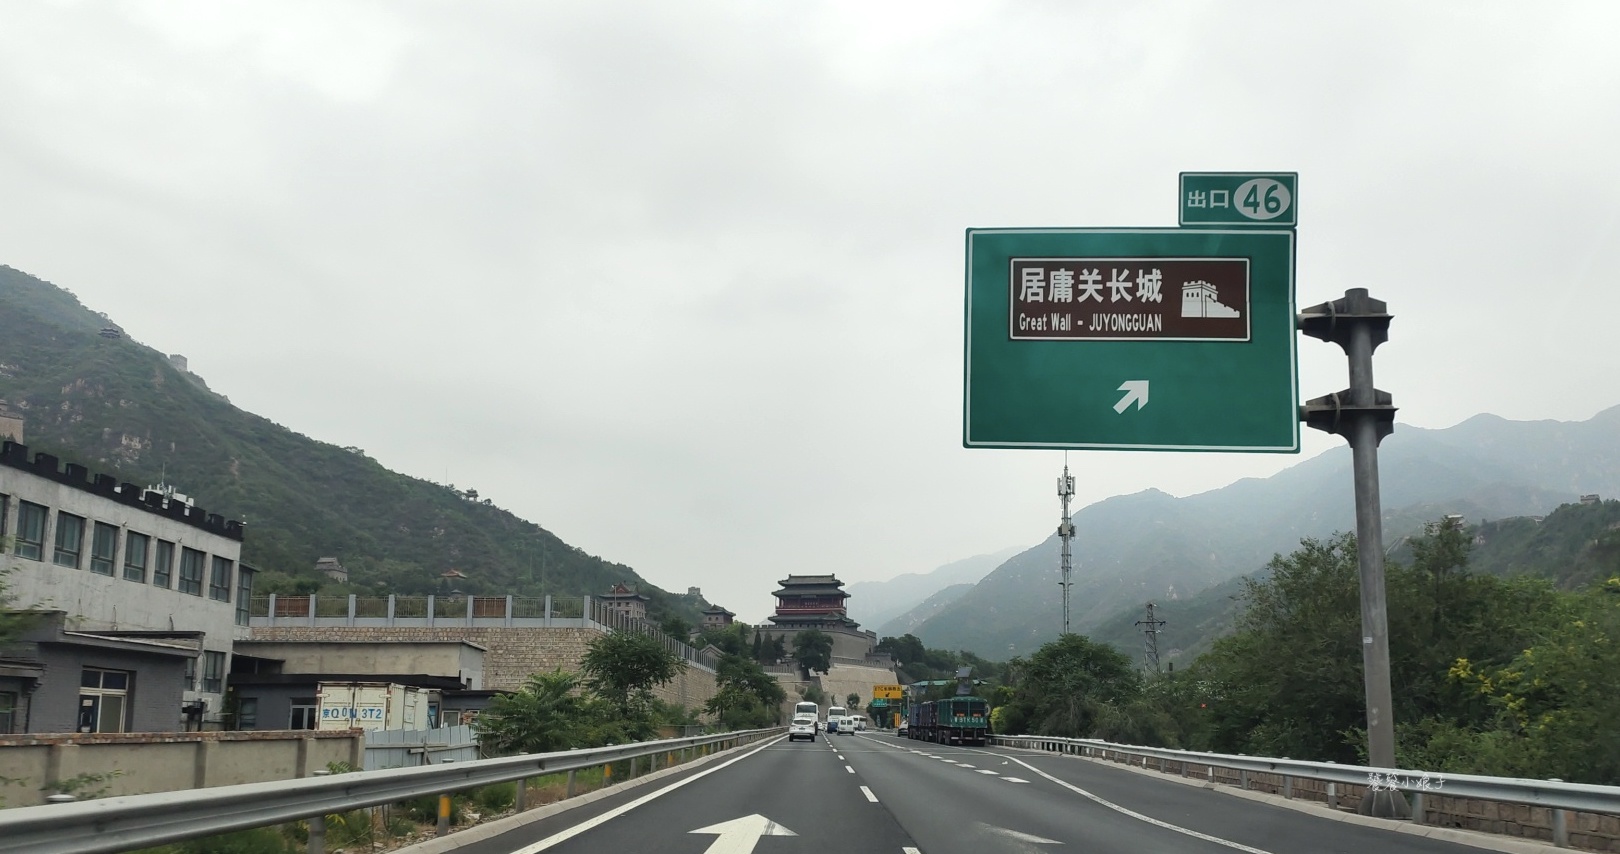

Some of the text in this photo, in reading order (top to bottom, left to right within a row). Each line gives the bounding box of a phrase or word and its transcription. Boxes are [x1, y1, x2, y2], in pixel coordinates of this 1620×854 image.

[1187, 184, 1281, 214] 出口 46
[1019, 267, 1163, 304] 居庸关长城
[1019, 313, 1047, 332] Great
[1051, 313, 1071, 332] Wall
[1089, 313, 1162, 332] JUYONGGUAN
